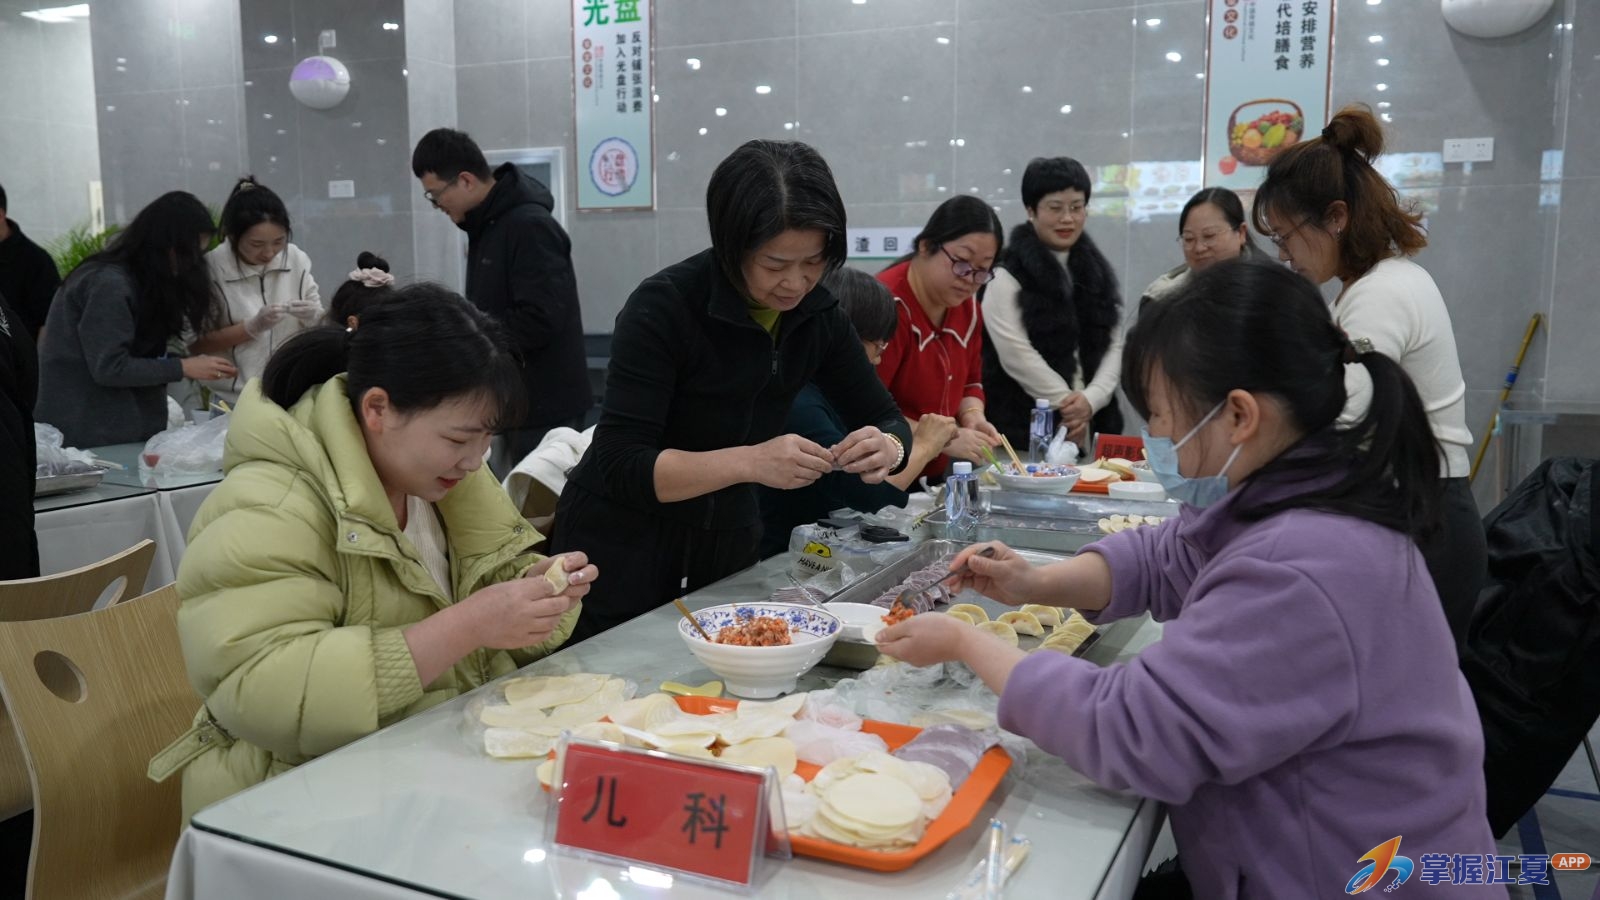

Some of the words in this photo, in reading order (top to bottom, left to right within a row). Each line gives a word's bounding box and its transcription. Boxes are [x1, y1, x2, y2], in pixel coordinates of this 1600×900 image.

[583, 0, 641, 26] 光盘
[1274, 0, 1292, 70] 代培膳食
[1299, 0, 1318, 69] 安排营养
[616, 34, 627, 113] 加入光盘行动
[631, 31, 642, 112] 反对铺张浪费
[582, 775, 729, 848] 儿科
